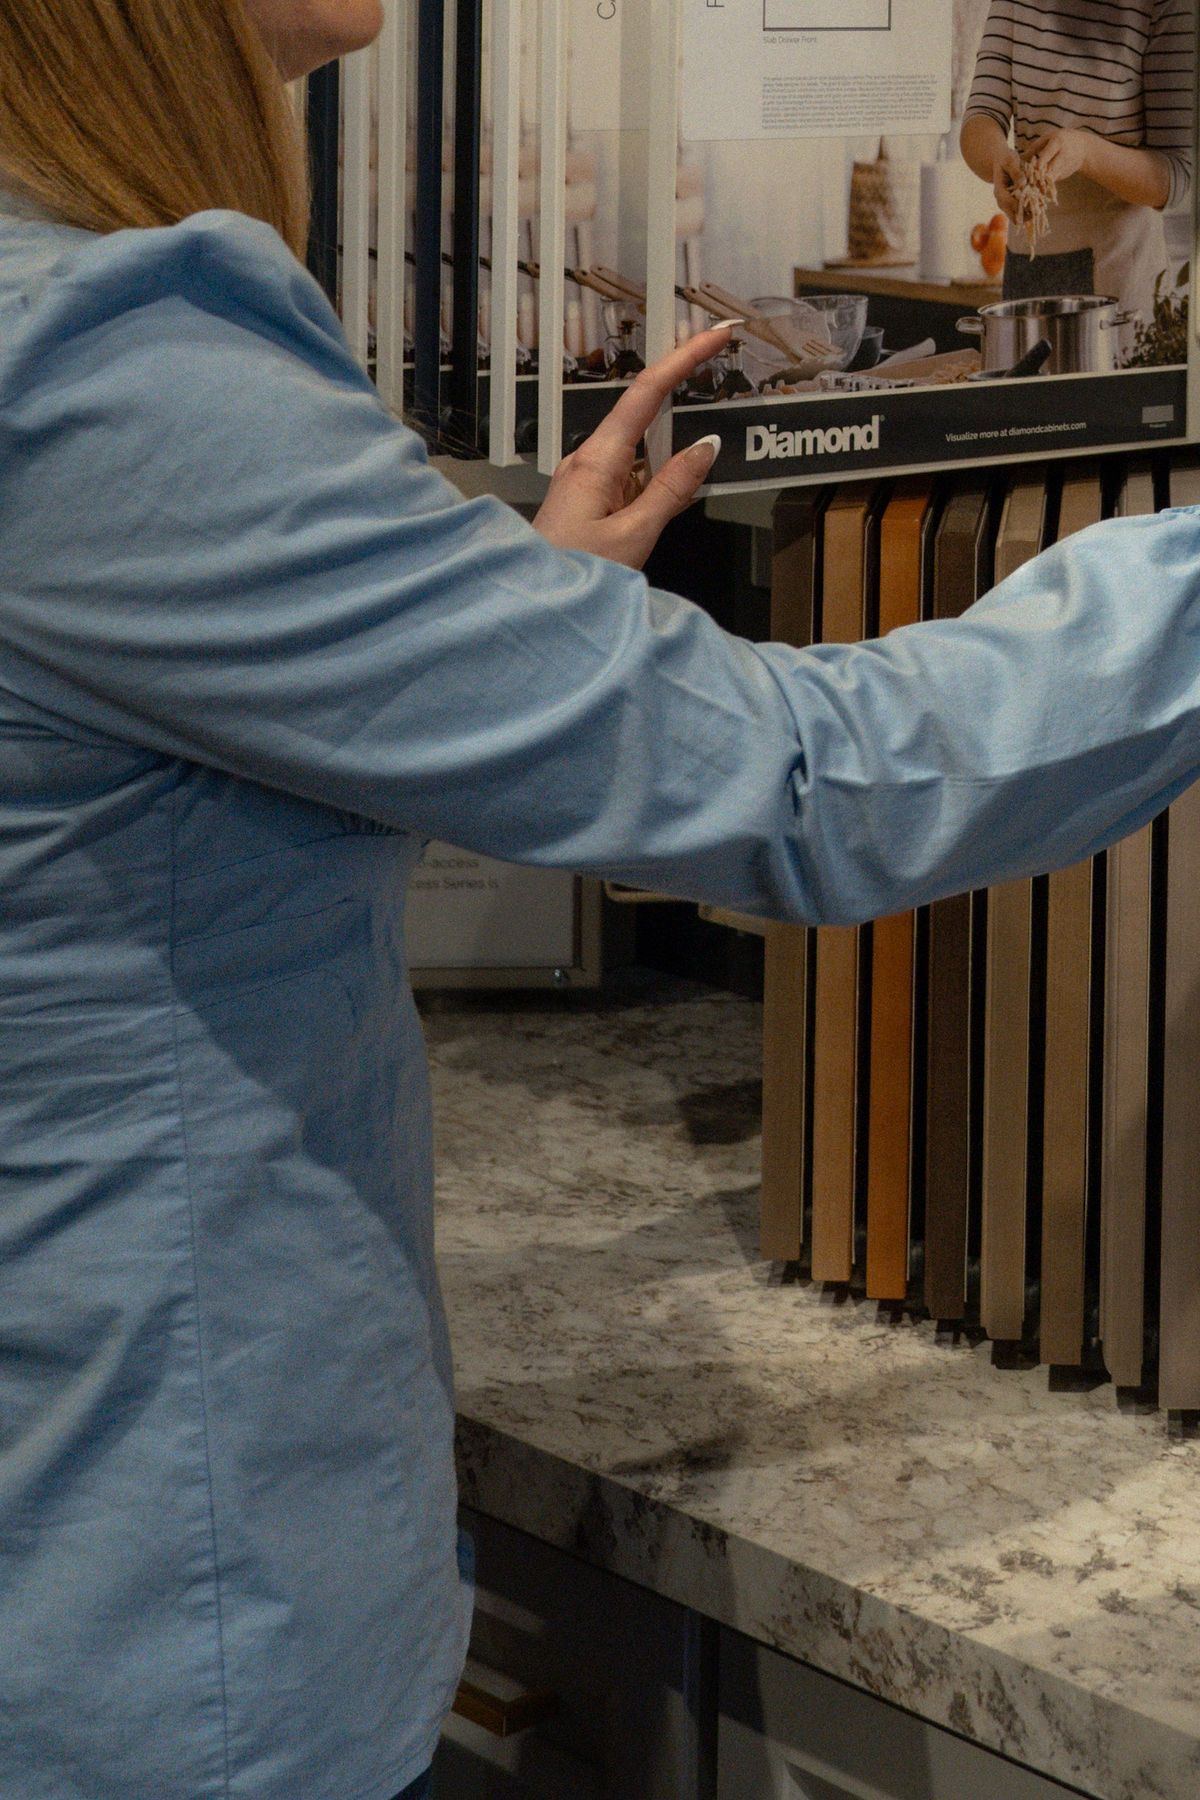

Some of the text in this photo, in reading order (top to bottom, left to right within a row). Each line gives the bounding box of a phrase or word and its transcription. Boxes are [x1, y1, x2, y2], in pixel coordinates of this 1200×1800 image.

[945, 421, 1087, 443] Visualize more at diamondcabinets.com
